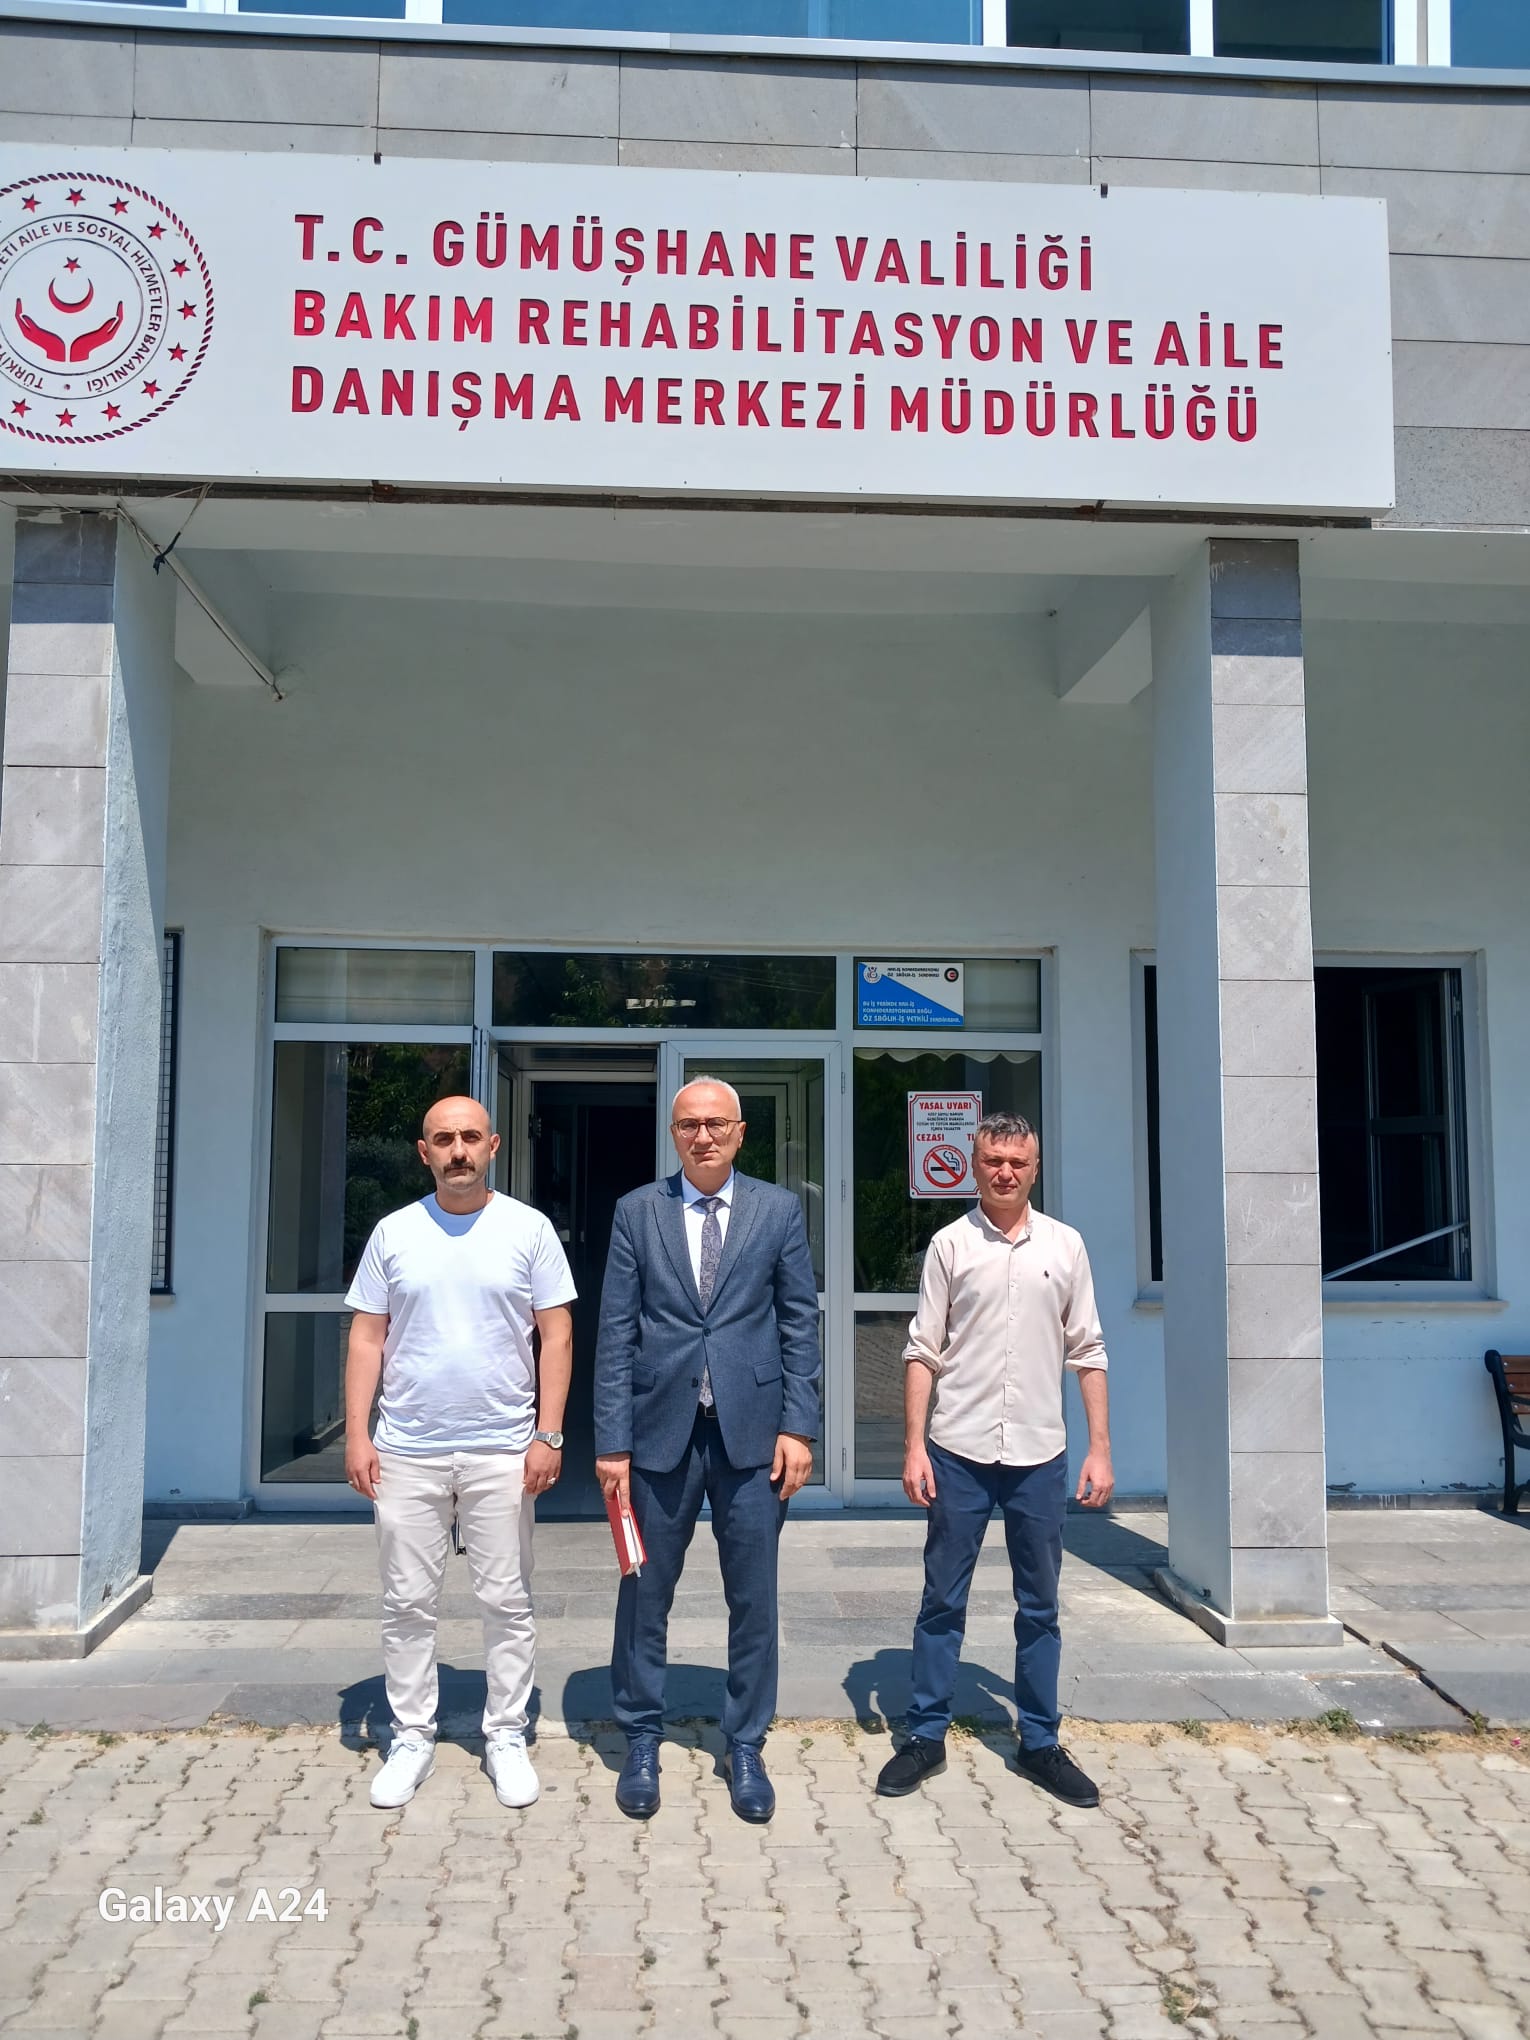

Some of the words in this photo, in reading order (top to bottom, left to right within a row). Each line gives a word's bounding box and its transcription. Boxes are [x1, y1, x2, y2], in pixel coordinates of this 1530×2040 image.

[18, 225, 51, 247] AİLE
[53, 221, 72, 233] VE
[77, 221, 132, 253] SOSYAL
[294, 213, 407, 265] T.C.
[433, 211, 814, 286] GÜMÜŞHANE
[836, 231, 1091, 291] VALİLİĞİ
[131, 250, 163, 332] HİZMETLER
[293, 289, 493, 343] BAKIM
[519, 295, 1043, 363] REHABİLİTASYON
[1065, 318, 1133, 365] VE
[1154, 312, 1284, 369] AİLE
[87, 334, 156, 393] BAKANLIĞI
[291, 366, 581, 431] DANIŞMA
[604, 373, 865, 430] MERKEZİ
[890, 378, 1257, 443] MÜDÜRLÜĞÜ
[863, 1014, 872, 1022] ÖZ
[919, 1102, 944, 1110] YASAL
[947, 1102, 972, 1110] UYARI
[916, 1133, 944, 1141] CEZASI
